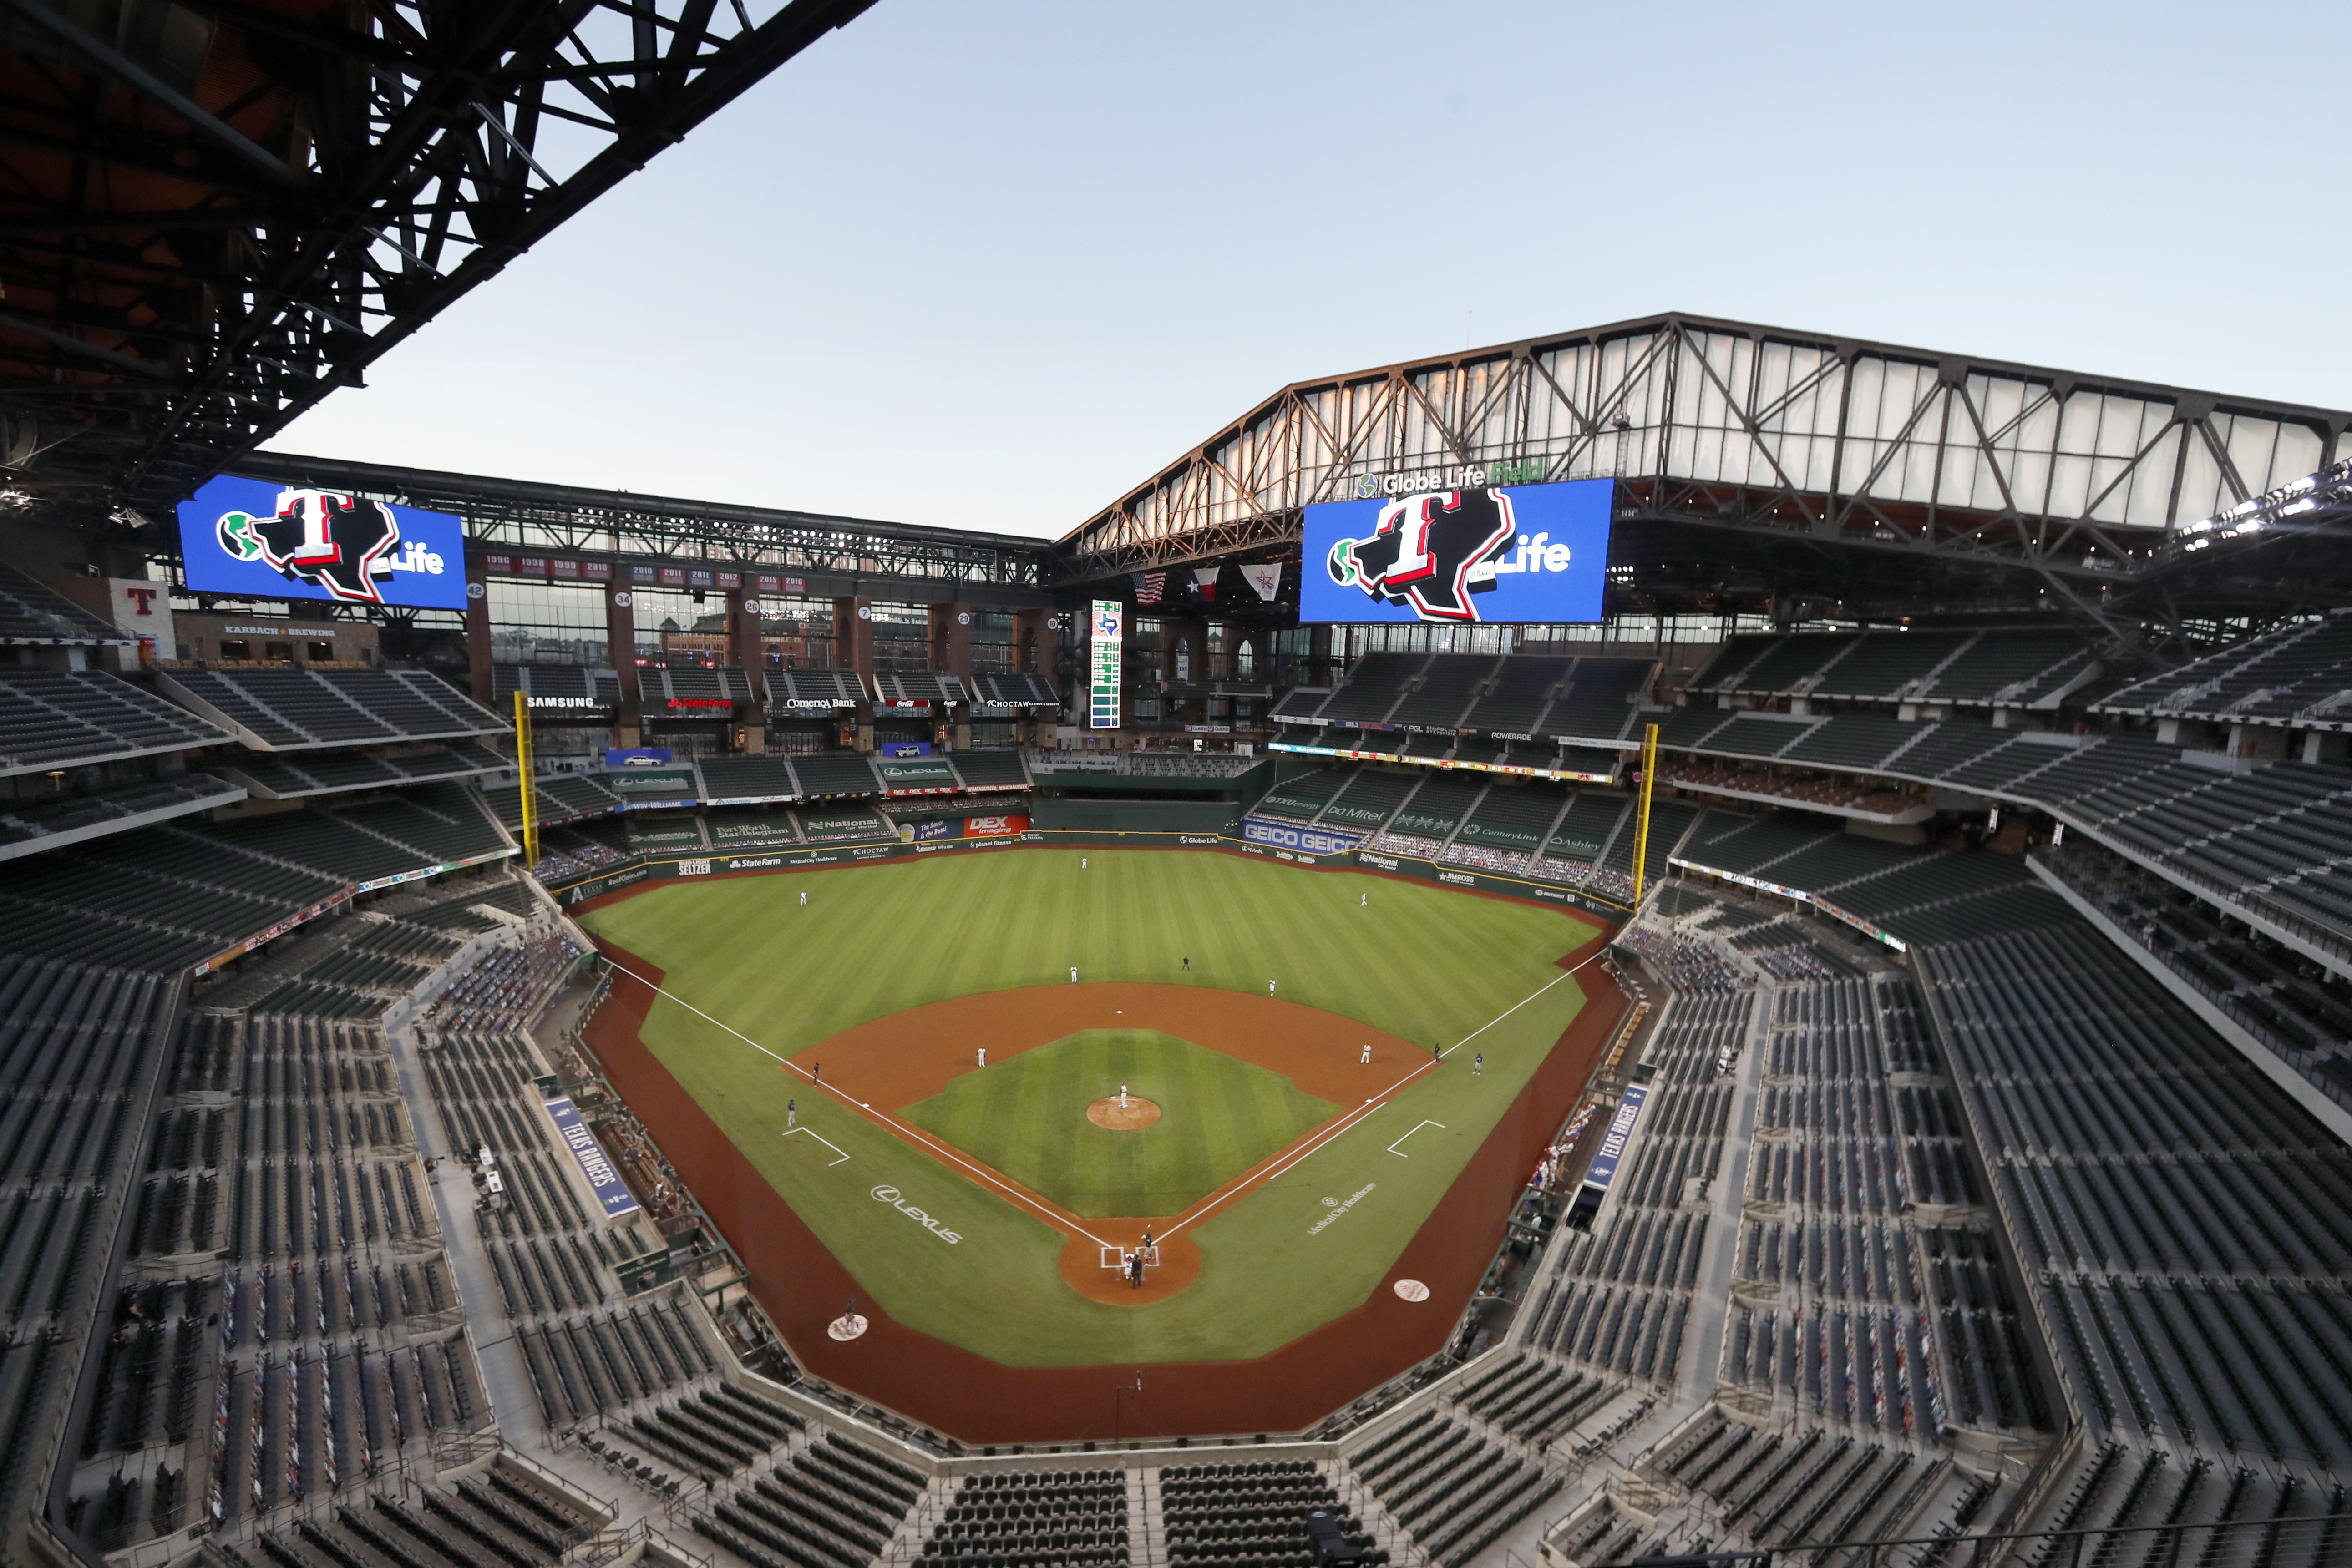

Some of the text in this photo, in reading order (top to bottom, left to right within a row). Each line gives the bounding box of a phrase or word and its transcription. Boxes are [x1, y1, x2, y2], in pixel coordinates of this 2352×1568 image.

[1383, 458, 1542, 494] Globe Life Field
[487, 555, 510, 564] 1996
[522, 558, 544, 567] 1998
[554, 560, 576, 568] 1999
[588, 563, 607, 571] 2010
[468, 587, 481, 595] 42
[126, 588, 157, 615] T
[225, 626, 335, 637] KARBACH BREWING
[527, 697, 593, 708] SAMSUNG
[832, 699, 855, 708] Bank
[1491, 732, 1531, 741] POWERADE
[1346, 809, 1384, 821] Mitel
[970, 817, 1009, 830] DEX
[934, 826, 947, 835] Boss!
[1245, 824, 1298, 845] GEICO
[1482, 829, 1539, 842] CenturyLink
[1563, 839, 1601, 850] Ashley
[679, 864, 711, 876] SELTZER
[608, 870, 647, 885] RoofClaim.com
[1599, 1103, 1638, 1159] TEXAS RANGERS
[562, 1122, 616, 1187] TEXAS RANGERS
[1307, 1183, 1376, 1236] Medical City Healthcare
[893, 1199, 963, 1244] LEXUS
